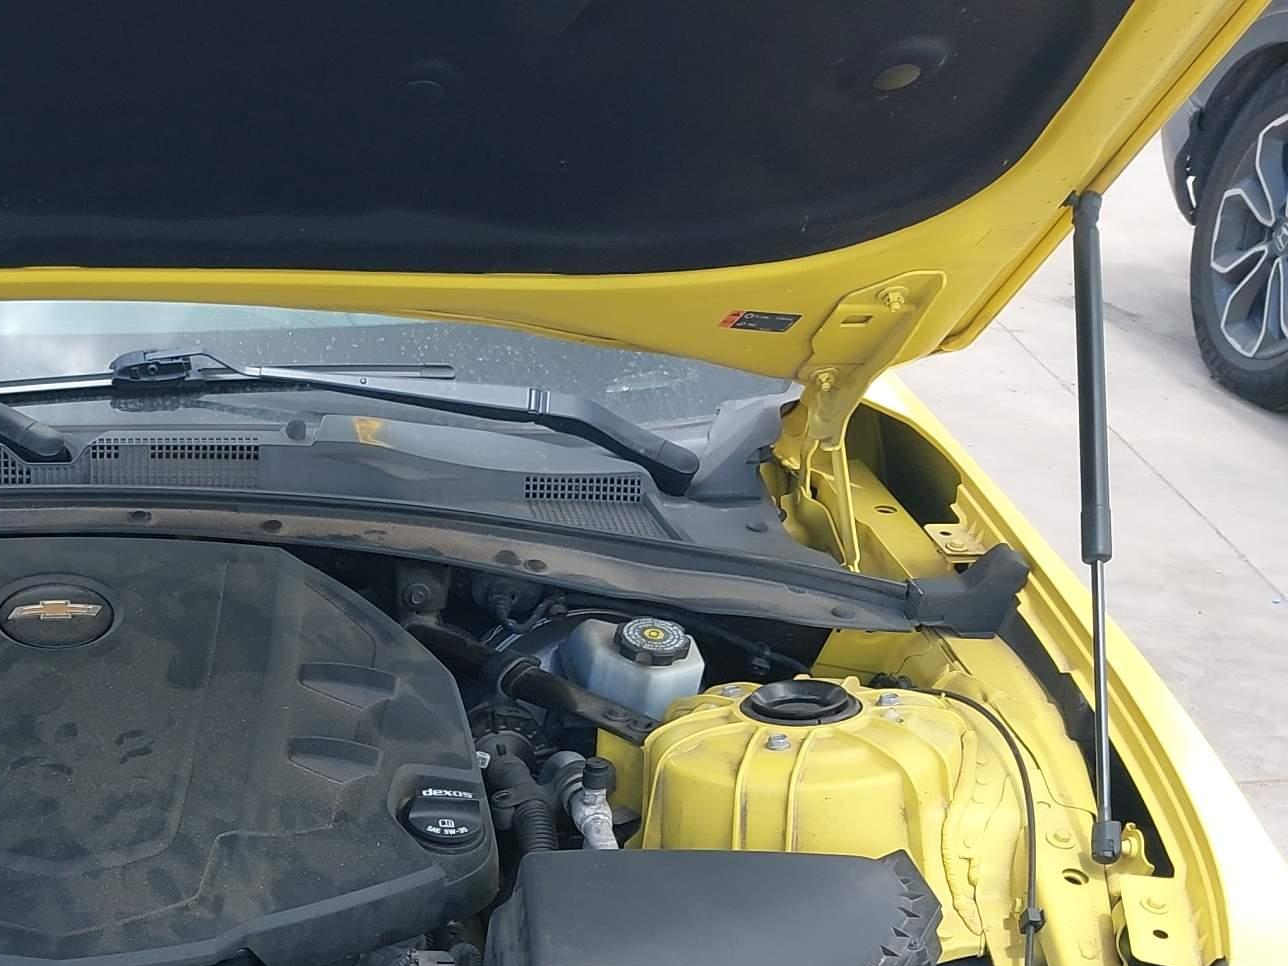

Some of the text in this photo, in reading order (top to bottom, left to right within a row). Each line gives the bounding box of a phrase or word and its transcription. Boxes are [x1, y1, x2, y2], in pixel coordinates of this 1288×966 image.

[421, 787, 473, 799] dexos
[426, 824, 469, 835] SAE 5W-30
